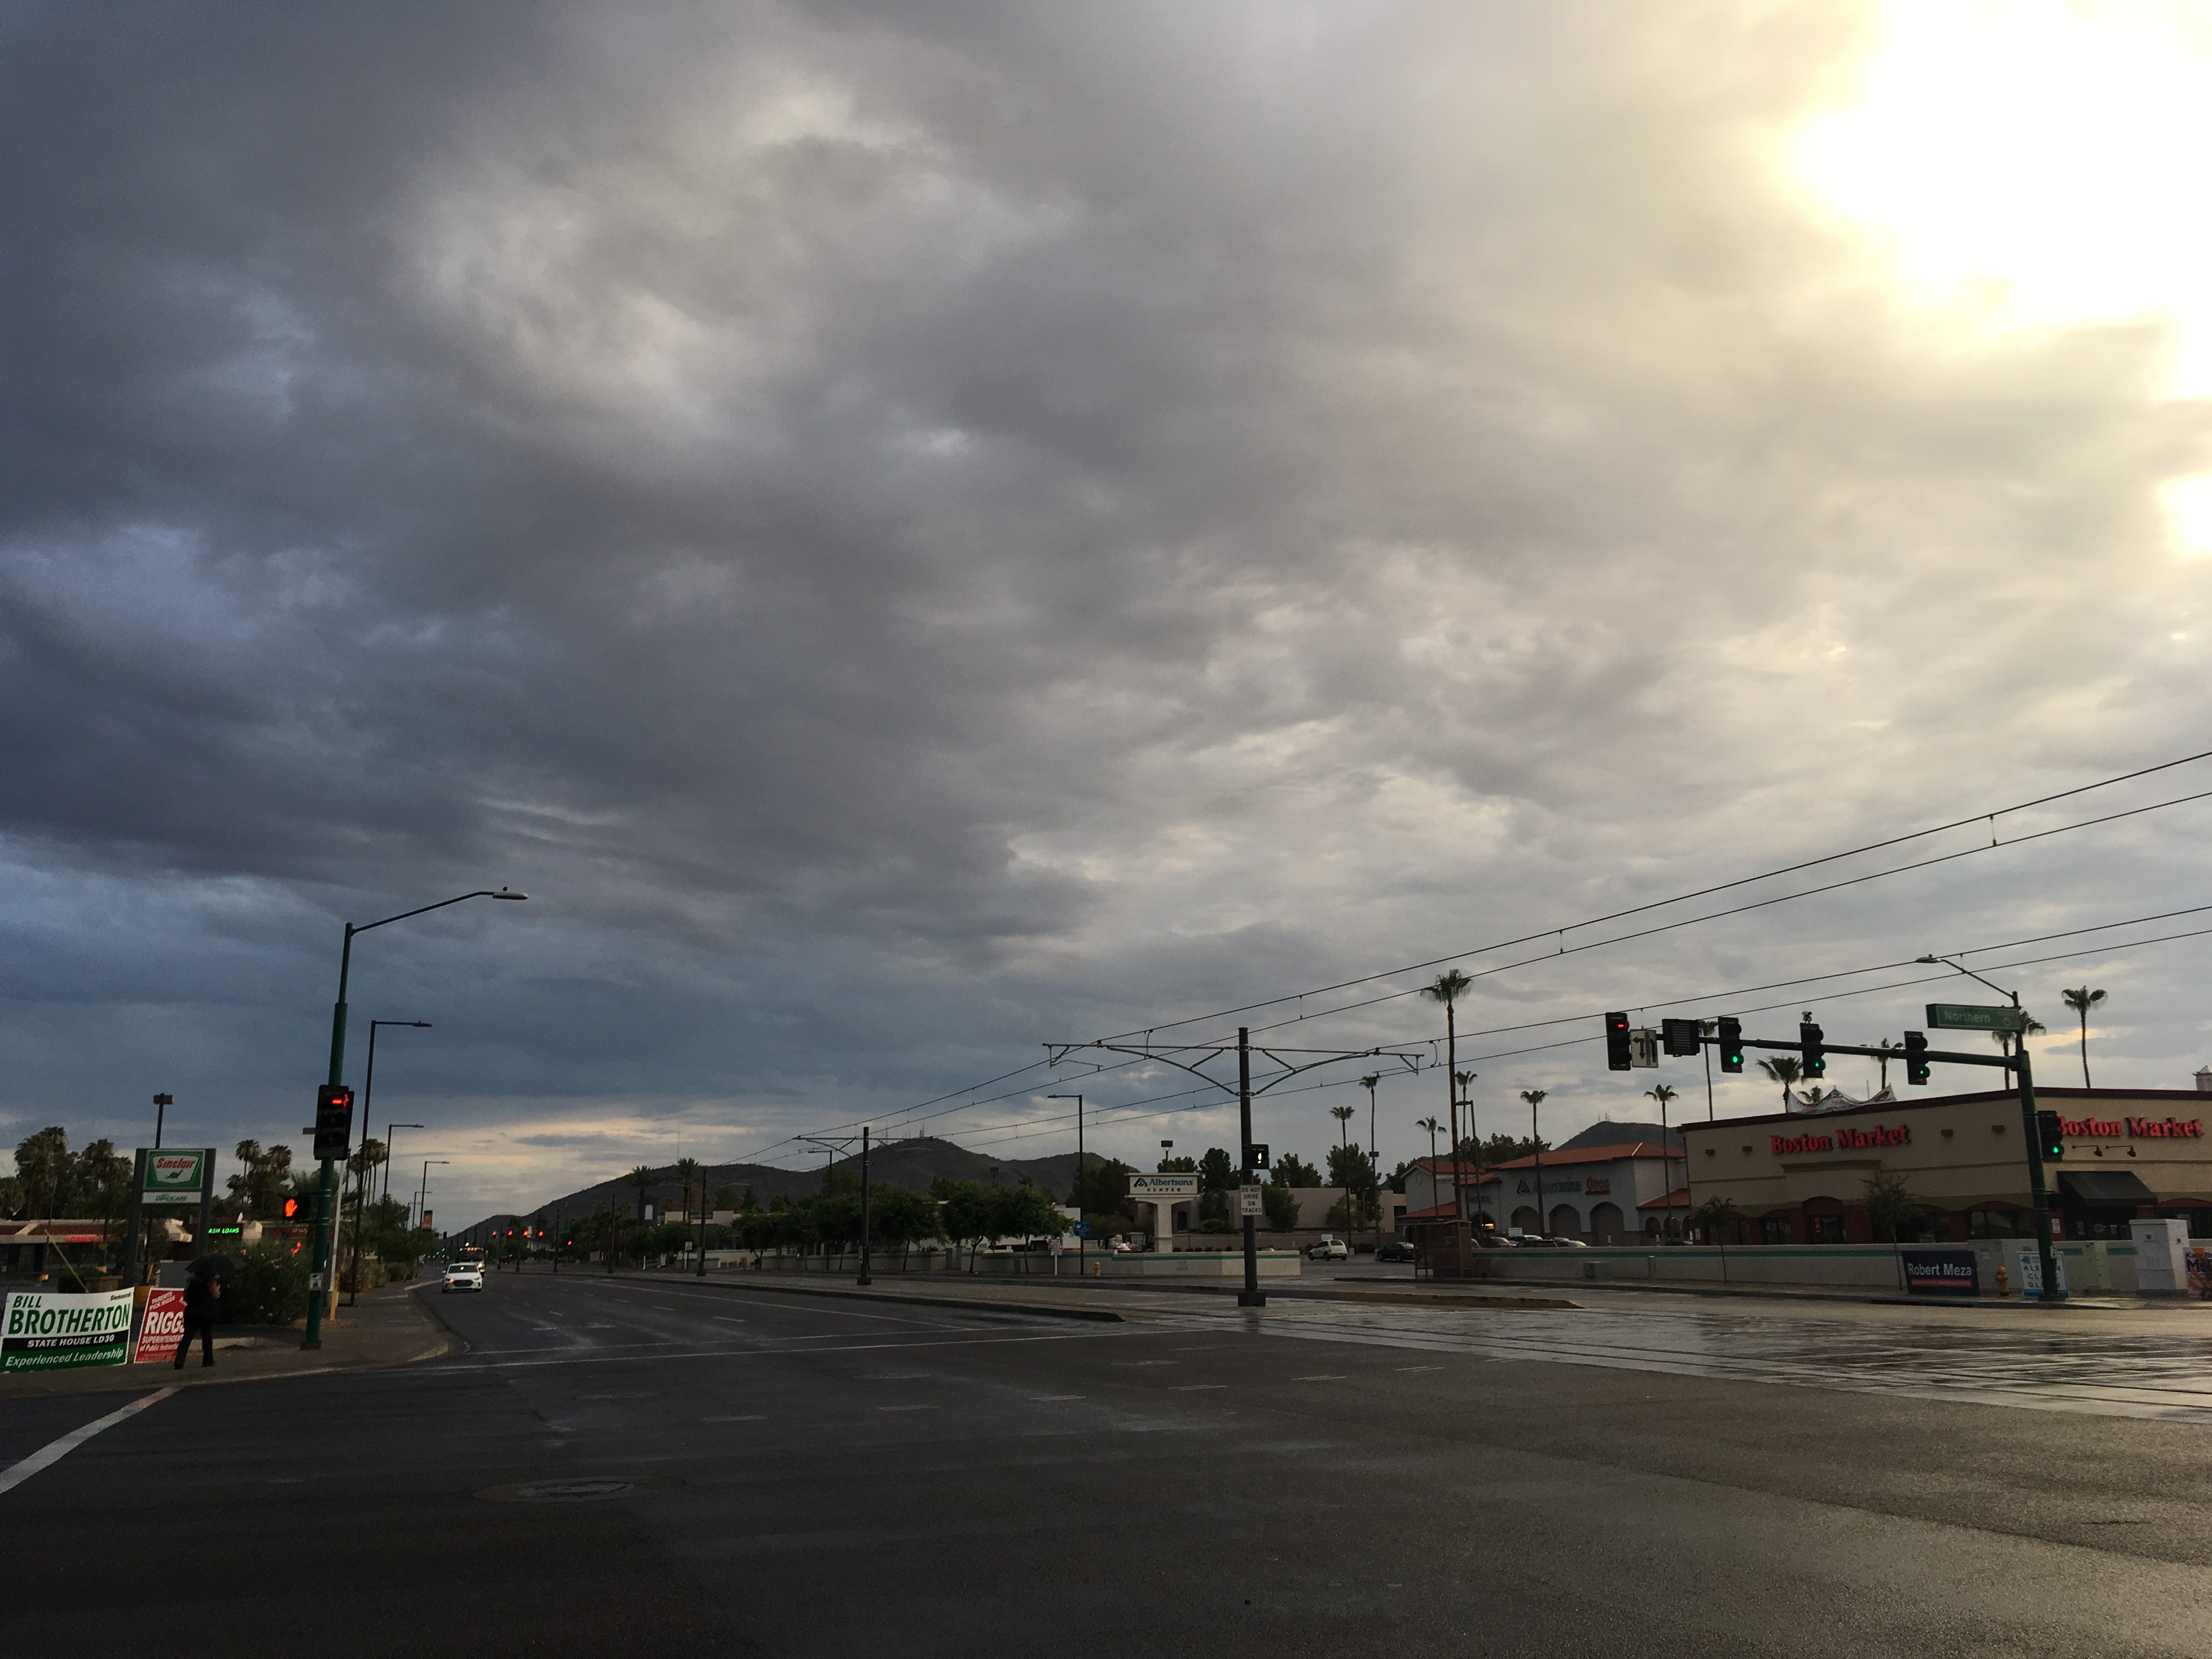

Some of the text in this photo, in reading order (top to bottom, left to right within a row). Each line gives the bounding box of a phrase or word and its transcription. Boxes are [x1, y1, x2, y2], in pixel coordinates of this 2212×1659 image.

[1944, 1011, 1991, 1023] Northern
[2057, 1115, 2204, 1137] Boston Market
[1770, 1125, 1909, 1154] Boston Market
[156, 1158, 196, 1169] Sinclair
[1907, 1263, 1972, 1276] Robert Meza
[13, 1295, 42, 1308] BILL
[8, 1303, 131, 1335] BROTHERTON
[27, 1334, 115, 1348] STATE HOUSE LD30
[5, 1353, 72, 1368] Experienced
[73, 1347, 123, 1362] Leadership
